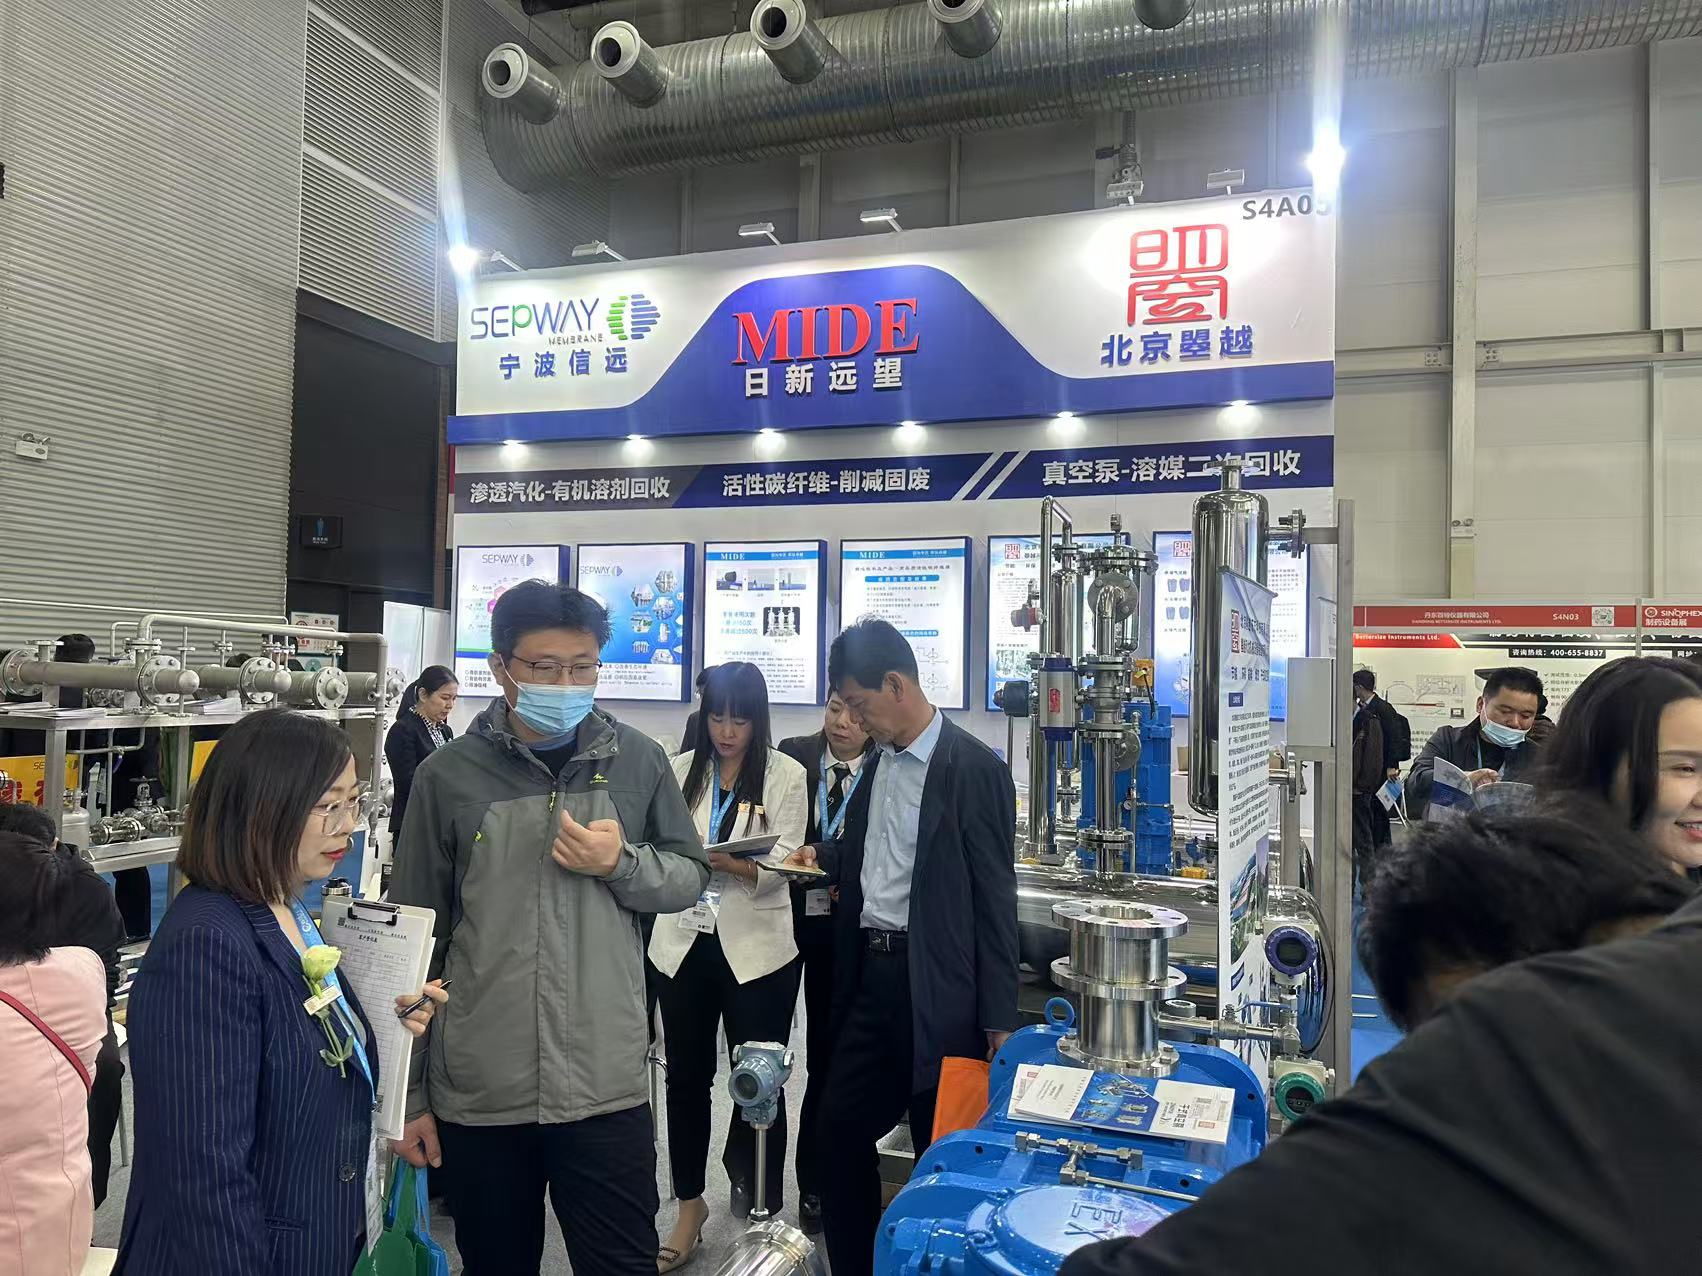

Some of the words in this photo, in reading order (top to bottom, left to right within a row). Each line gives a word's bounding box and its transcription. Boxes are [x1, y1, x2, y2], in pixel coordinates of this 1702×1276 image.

[470, 297, 600, 340] SEPWAY
[731, 297, 921, 367] MIDE
[548, 333, 604, 347] MEMBRANE
[499, 346, 629, 381] 宁波信远
[744, 356, 904, 398] 日新远望
[722, 466, 931, 497] 活性碳纤维-削减固废
[470, 475, 671, 504] 渗透汽化-有机溶剂回收
[481, 554, 519, 564] SEPWAY
[720, 552, 746, 561] MIDE
[859, 551, 886, 560] MIDE
[580, 565, 611, 575] SEPWAY
[1552, 612, 1580, 621] S4N03
[1387, 633, 1426, 641] Instruments
[1427, 633, 1440, 641] Ltd.
